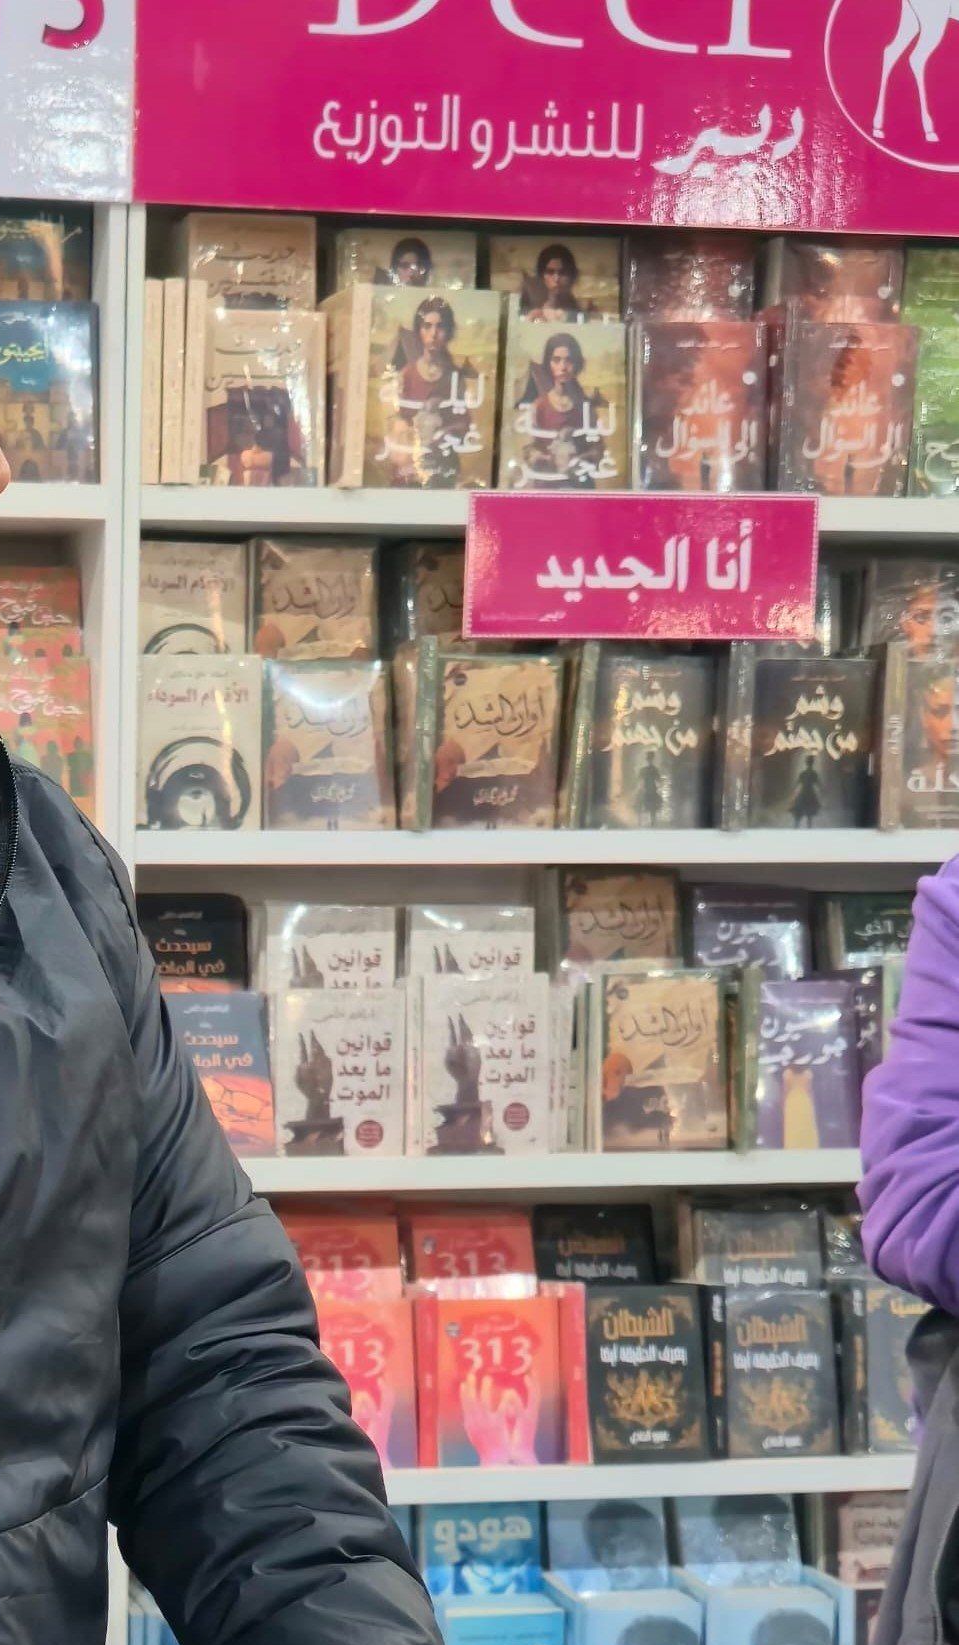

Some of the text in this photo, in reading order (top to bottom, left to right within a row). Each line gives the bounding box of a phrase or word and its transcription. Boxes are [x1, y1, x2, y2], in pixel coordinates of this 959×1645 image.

[496, 102, 645, 170] للنشر
[514, 401, 617, 443] ليلة
[536, 518, 754, 603] أنا الجديد
[328, 948, 382, 972] قوانين
[469, 947, 522, 971] قوانين
[336, 1032, 393, 1056] قوانين
[486, 1043, 536, 1065] ما بعد
[336, 1059, 392, 1082] ما بعد
[485, 1066, 536, 1089] الموت
[336, 1083, 391, 1107] الموت
[602, 1304, 675, 1341] الشيطان
[460, 1335, 532, 1376] 313
[434, 1514, 532, 1562] هودو
